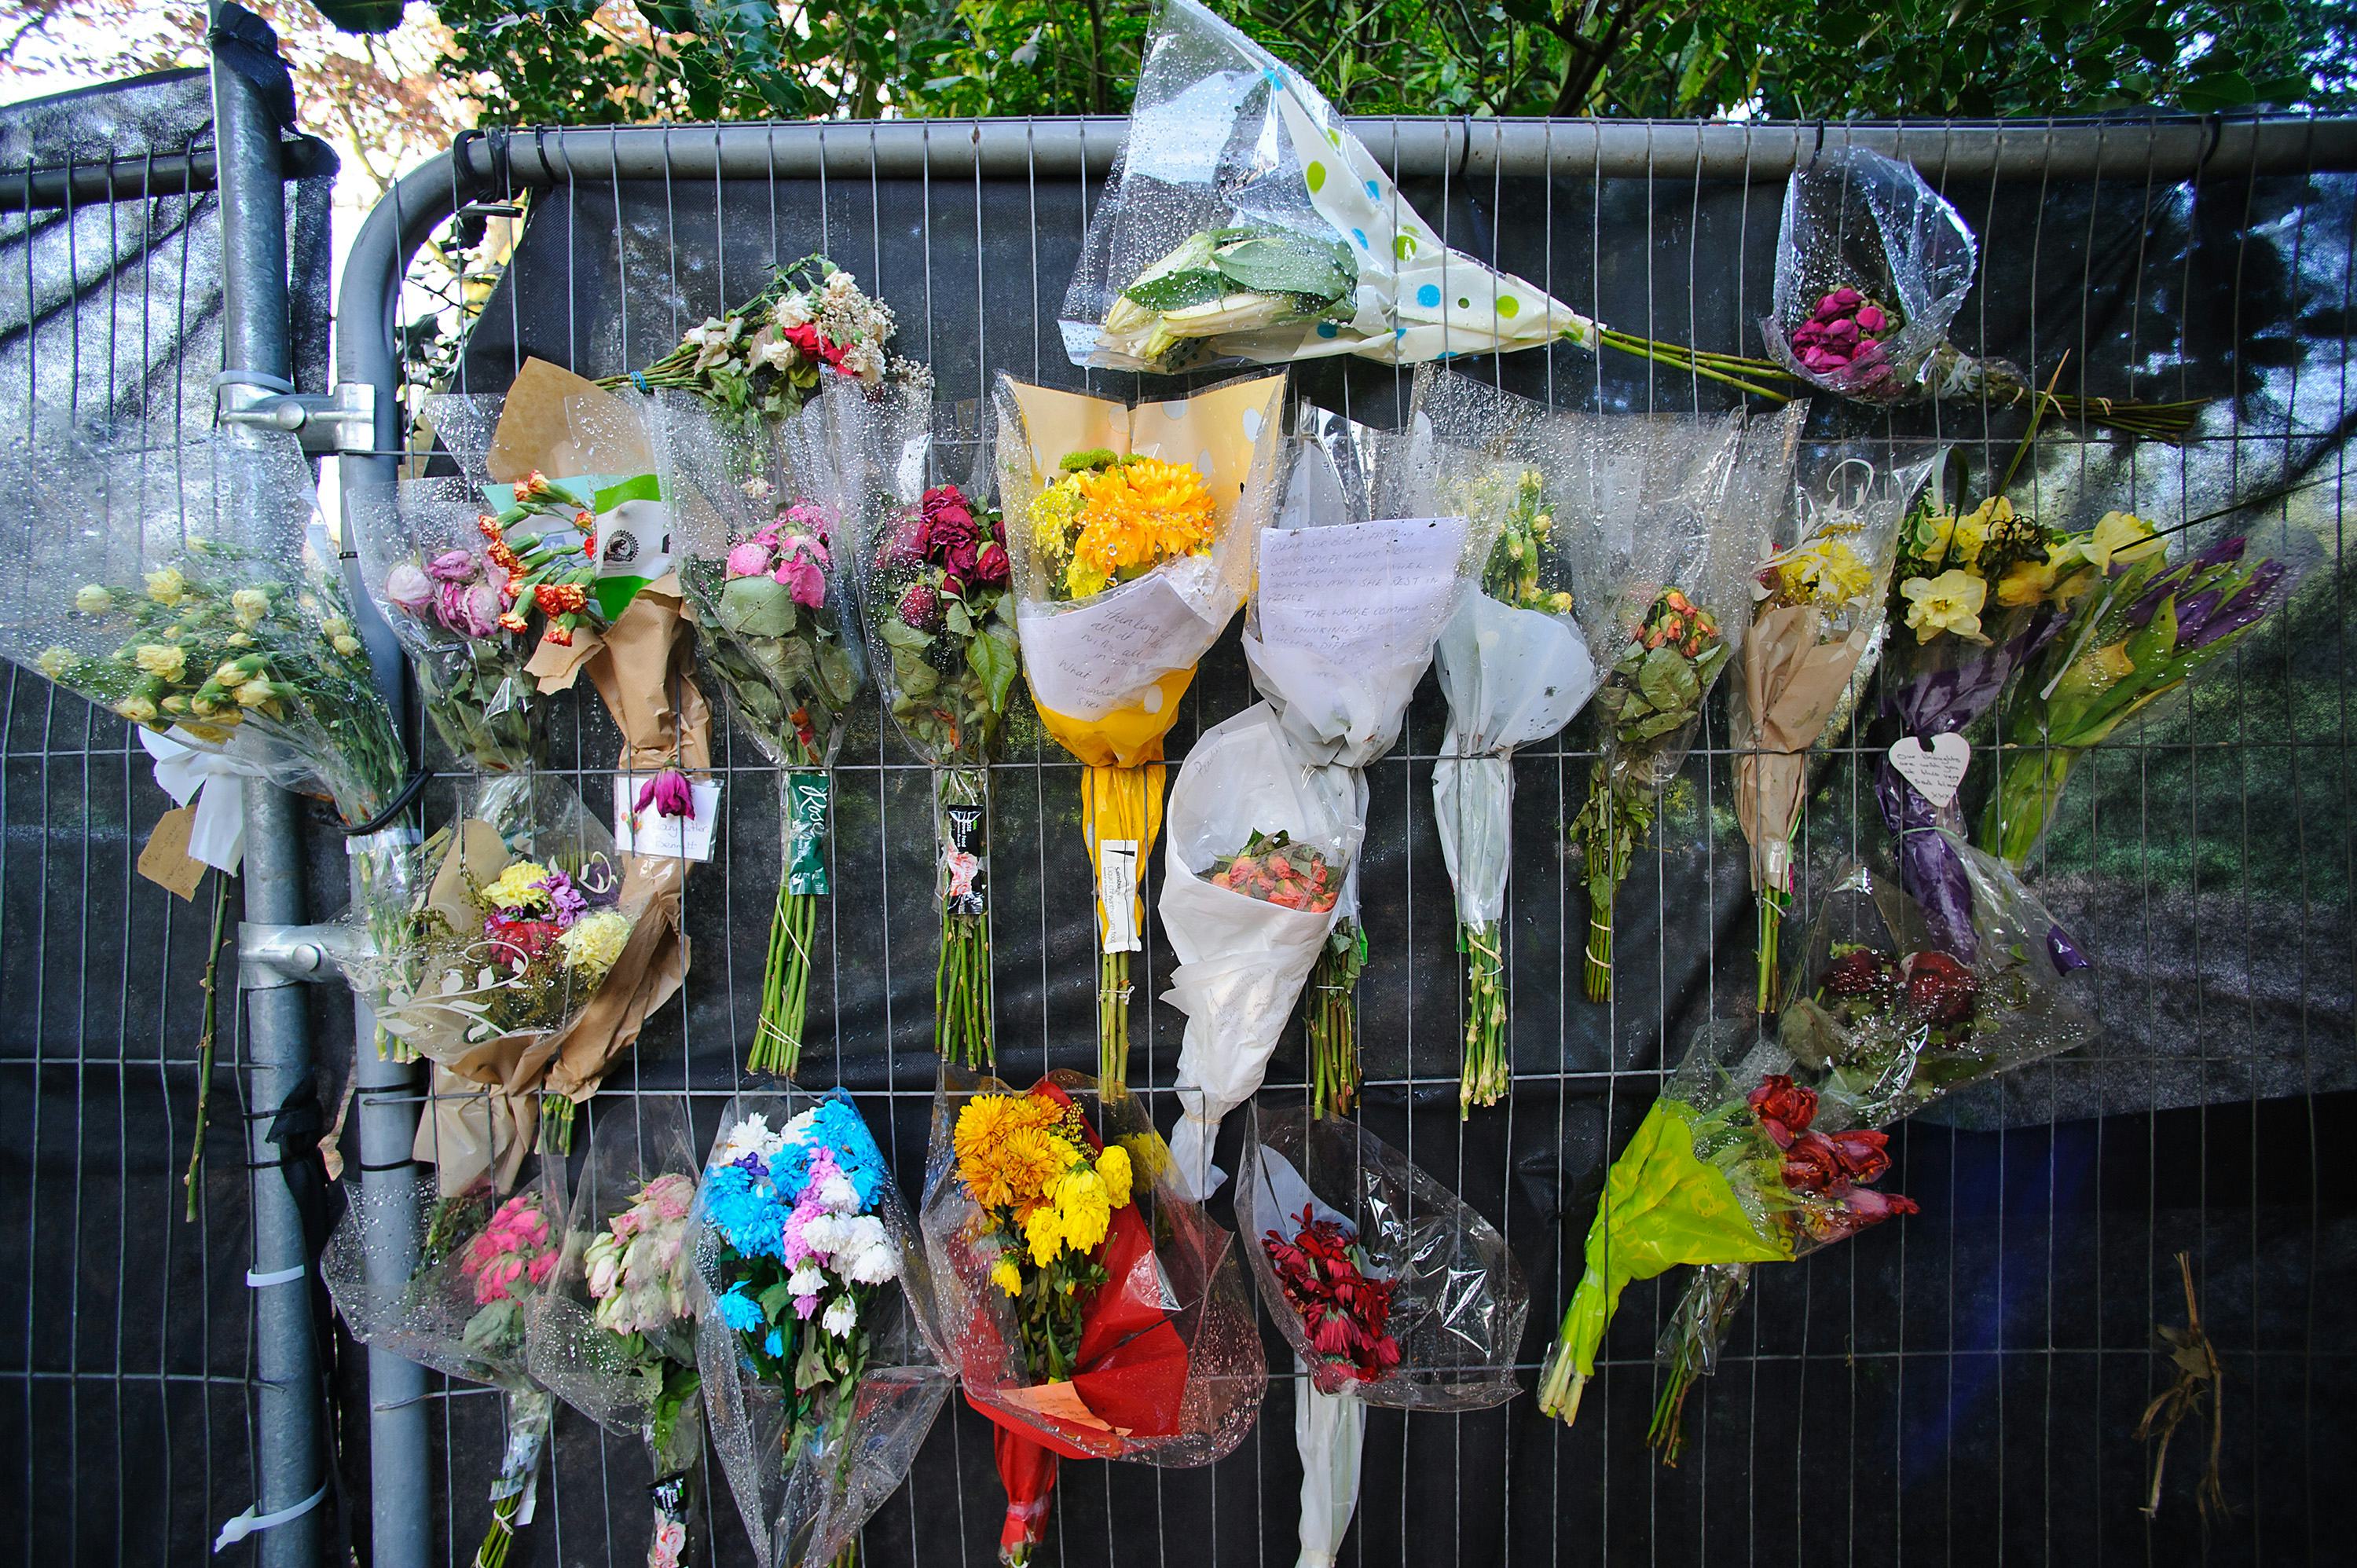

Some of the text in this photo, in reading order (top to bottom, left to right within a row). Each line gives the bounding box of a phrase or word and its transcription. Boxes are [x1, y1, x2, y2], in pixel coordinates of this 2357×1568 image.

[1270, 542, 1303, 552] DEAR
[1360, 578, 1382, 587] SHE
[1392, 577, 1420, 586] REST
[1266, 593, 1306, 604] PEACE
[1304, 609, 1327, 618] THE
[1332, 607, 1369, 617] WHOLE
[1293, 624, 1350, 634] THINKING
[1922, 753, 1961, 765] thoughts
[798, 785, 828, 837] Rose
